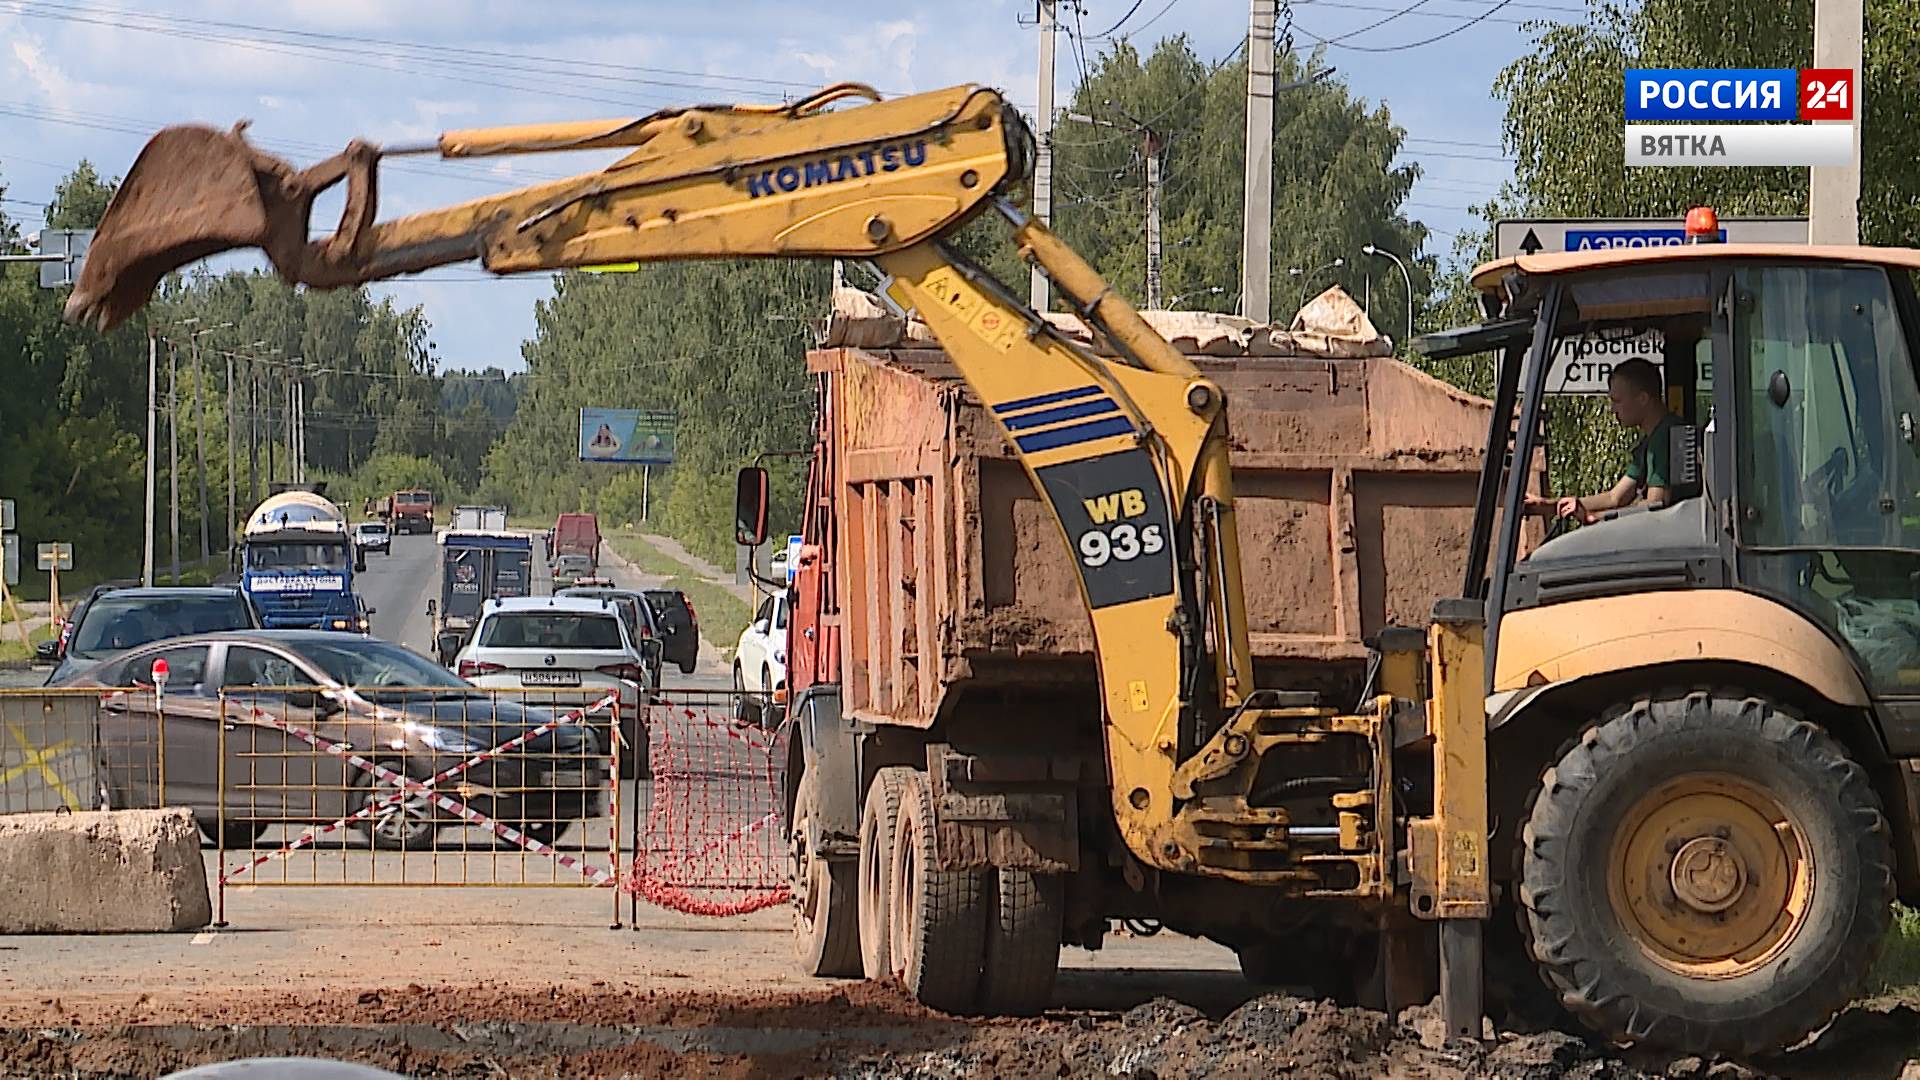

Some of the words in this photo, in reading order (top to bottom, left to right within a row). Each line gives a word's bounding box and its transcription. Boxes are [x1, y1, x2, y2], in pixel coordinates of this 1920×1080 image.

[747, 140, 927, 198] KOMATSU
[1578, 237, 1684, 251] АЭРОПО
[1565, 340, 1666, 359] проспек
[1084, 489, 1147, 524] WB
[1080, 524, 1164, 567] 93s
